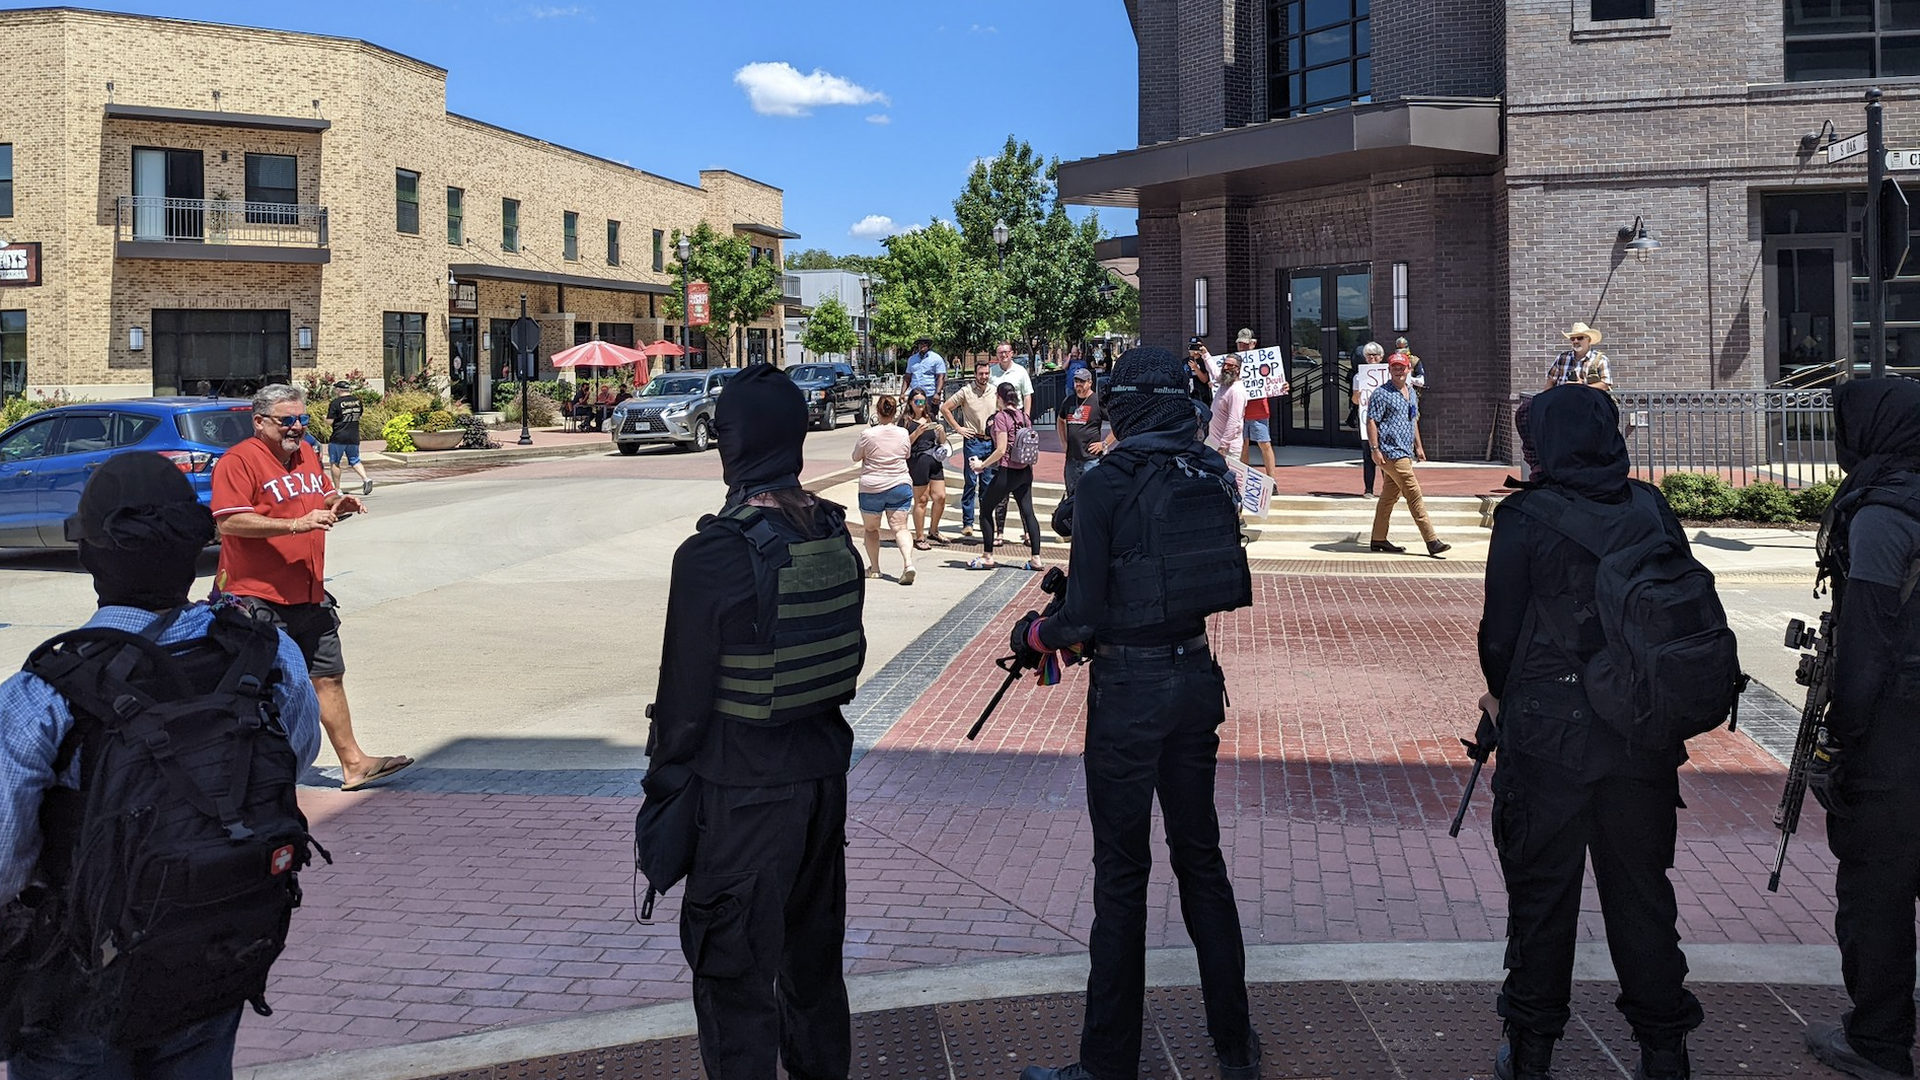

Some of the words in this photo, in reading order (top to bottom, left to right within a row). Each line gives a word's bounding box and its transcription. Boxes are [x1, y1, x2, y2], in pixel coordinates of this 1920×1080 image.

[1840, 144, 1844, 156] S
[1846, 139, 1857, 153] OAK
[1258, 349, 1275, 362] Be
[1243, 467, 1263, 513] CONSENT
